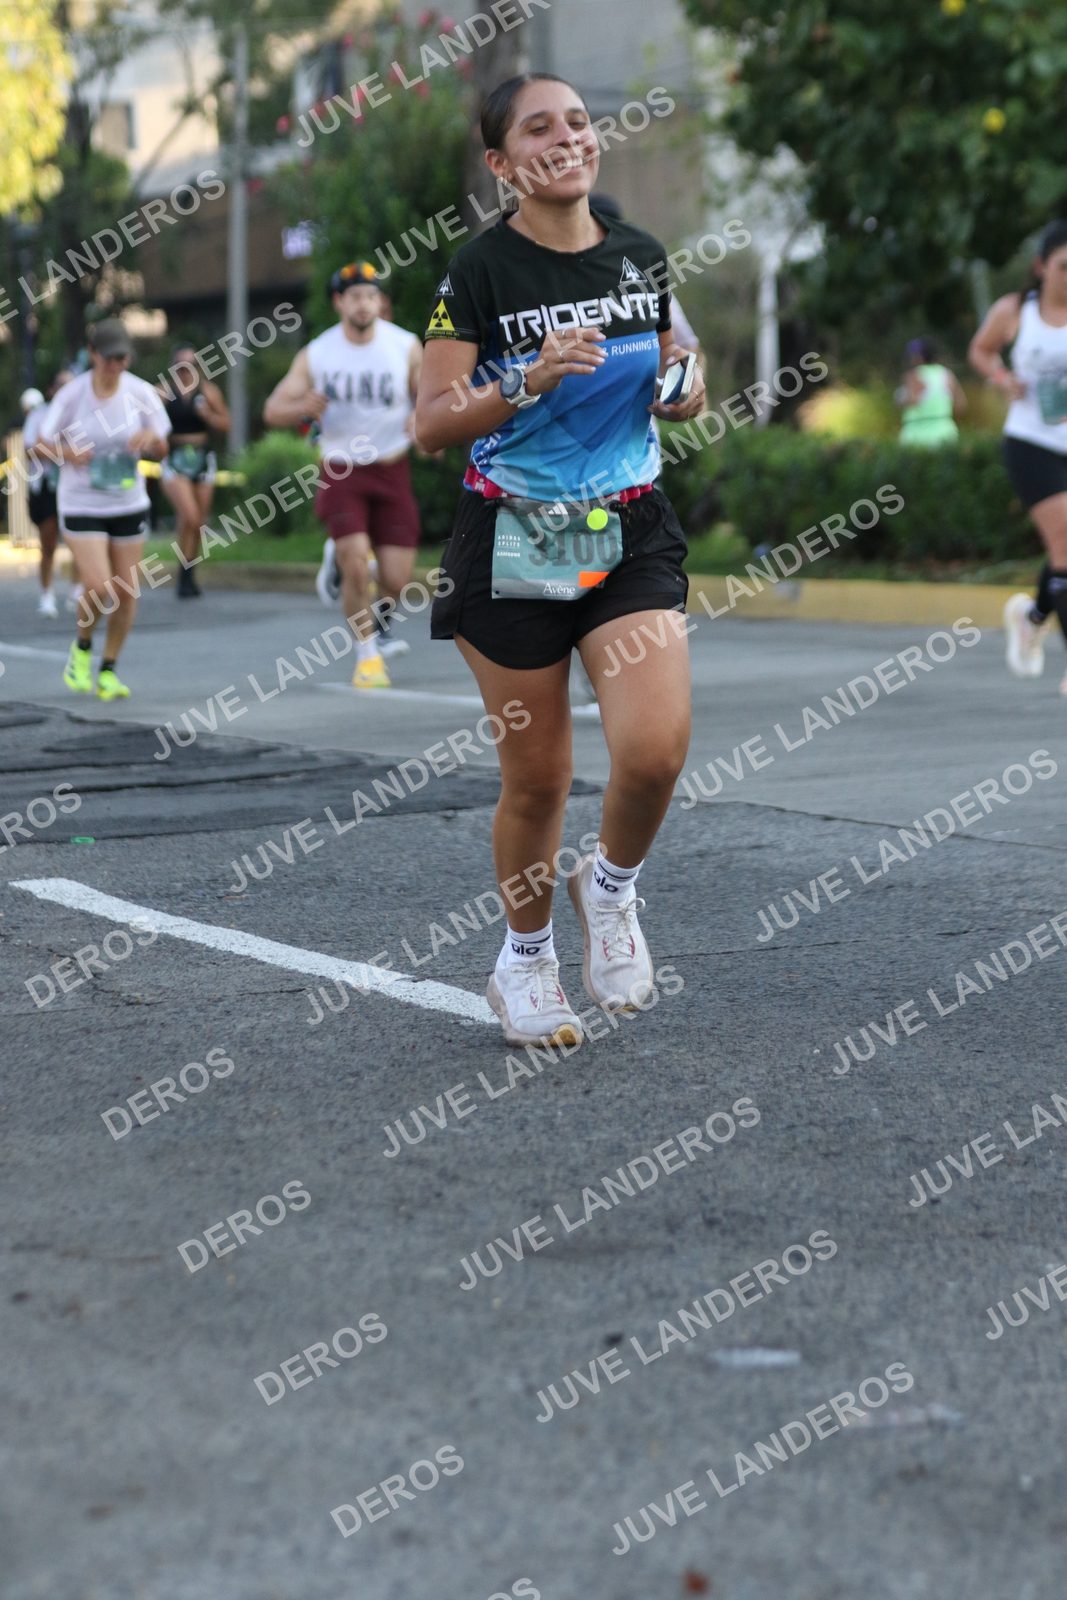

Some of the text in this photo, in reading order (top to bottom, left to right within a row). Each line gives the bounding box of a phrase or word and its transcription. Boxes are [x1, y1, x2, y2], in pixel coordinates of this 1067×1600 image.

[499, 293, 660, 344] TRIDENTE
[611, 339, 652, 356] RUNNING
[322, 371, 393, 406] KING
[543, 582, 576, 594] Avène
[511, 943, 540, 955] alo
